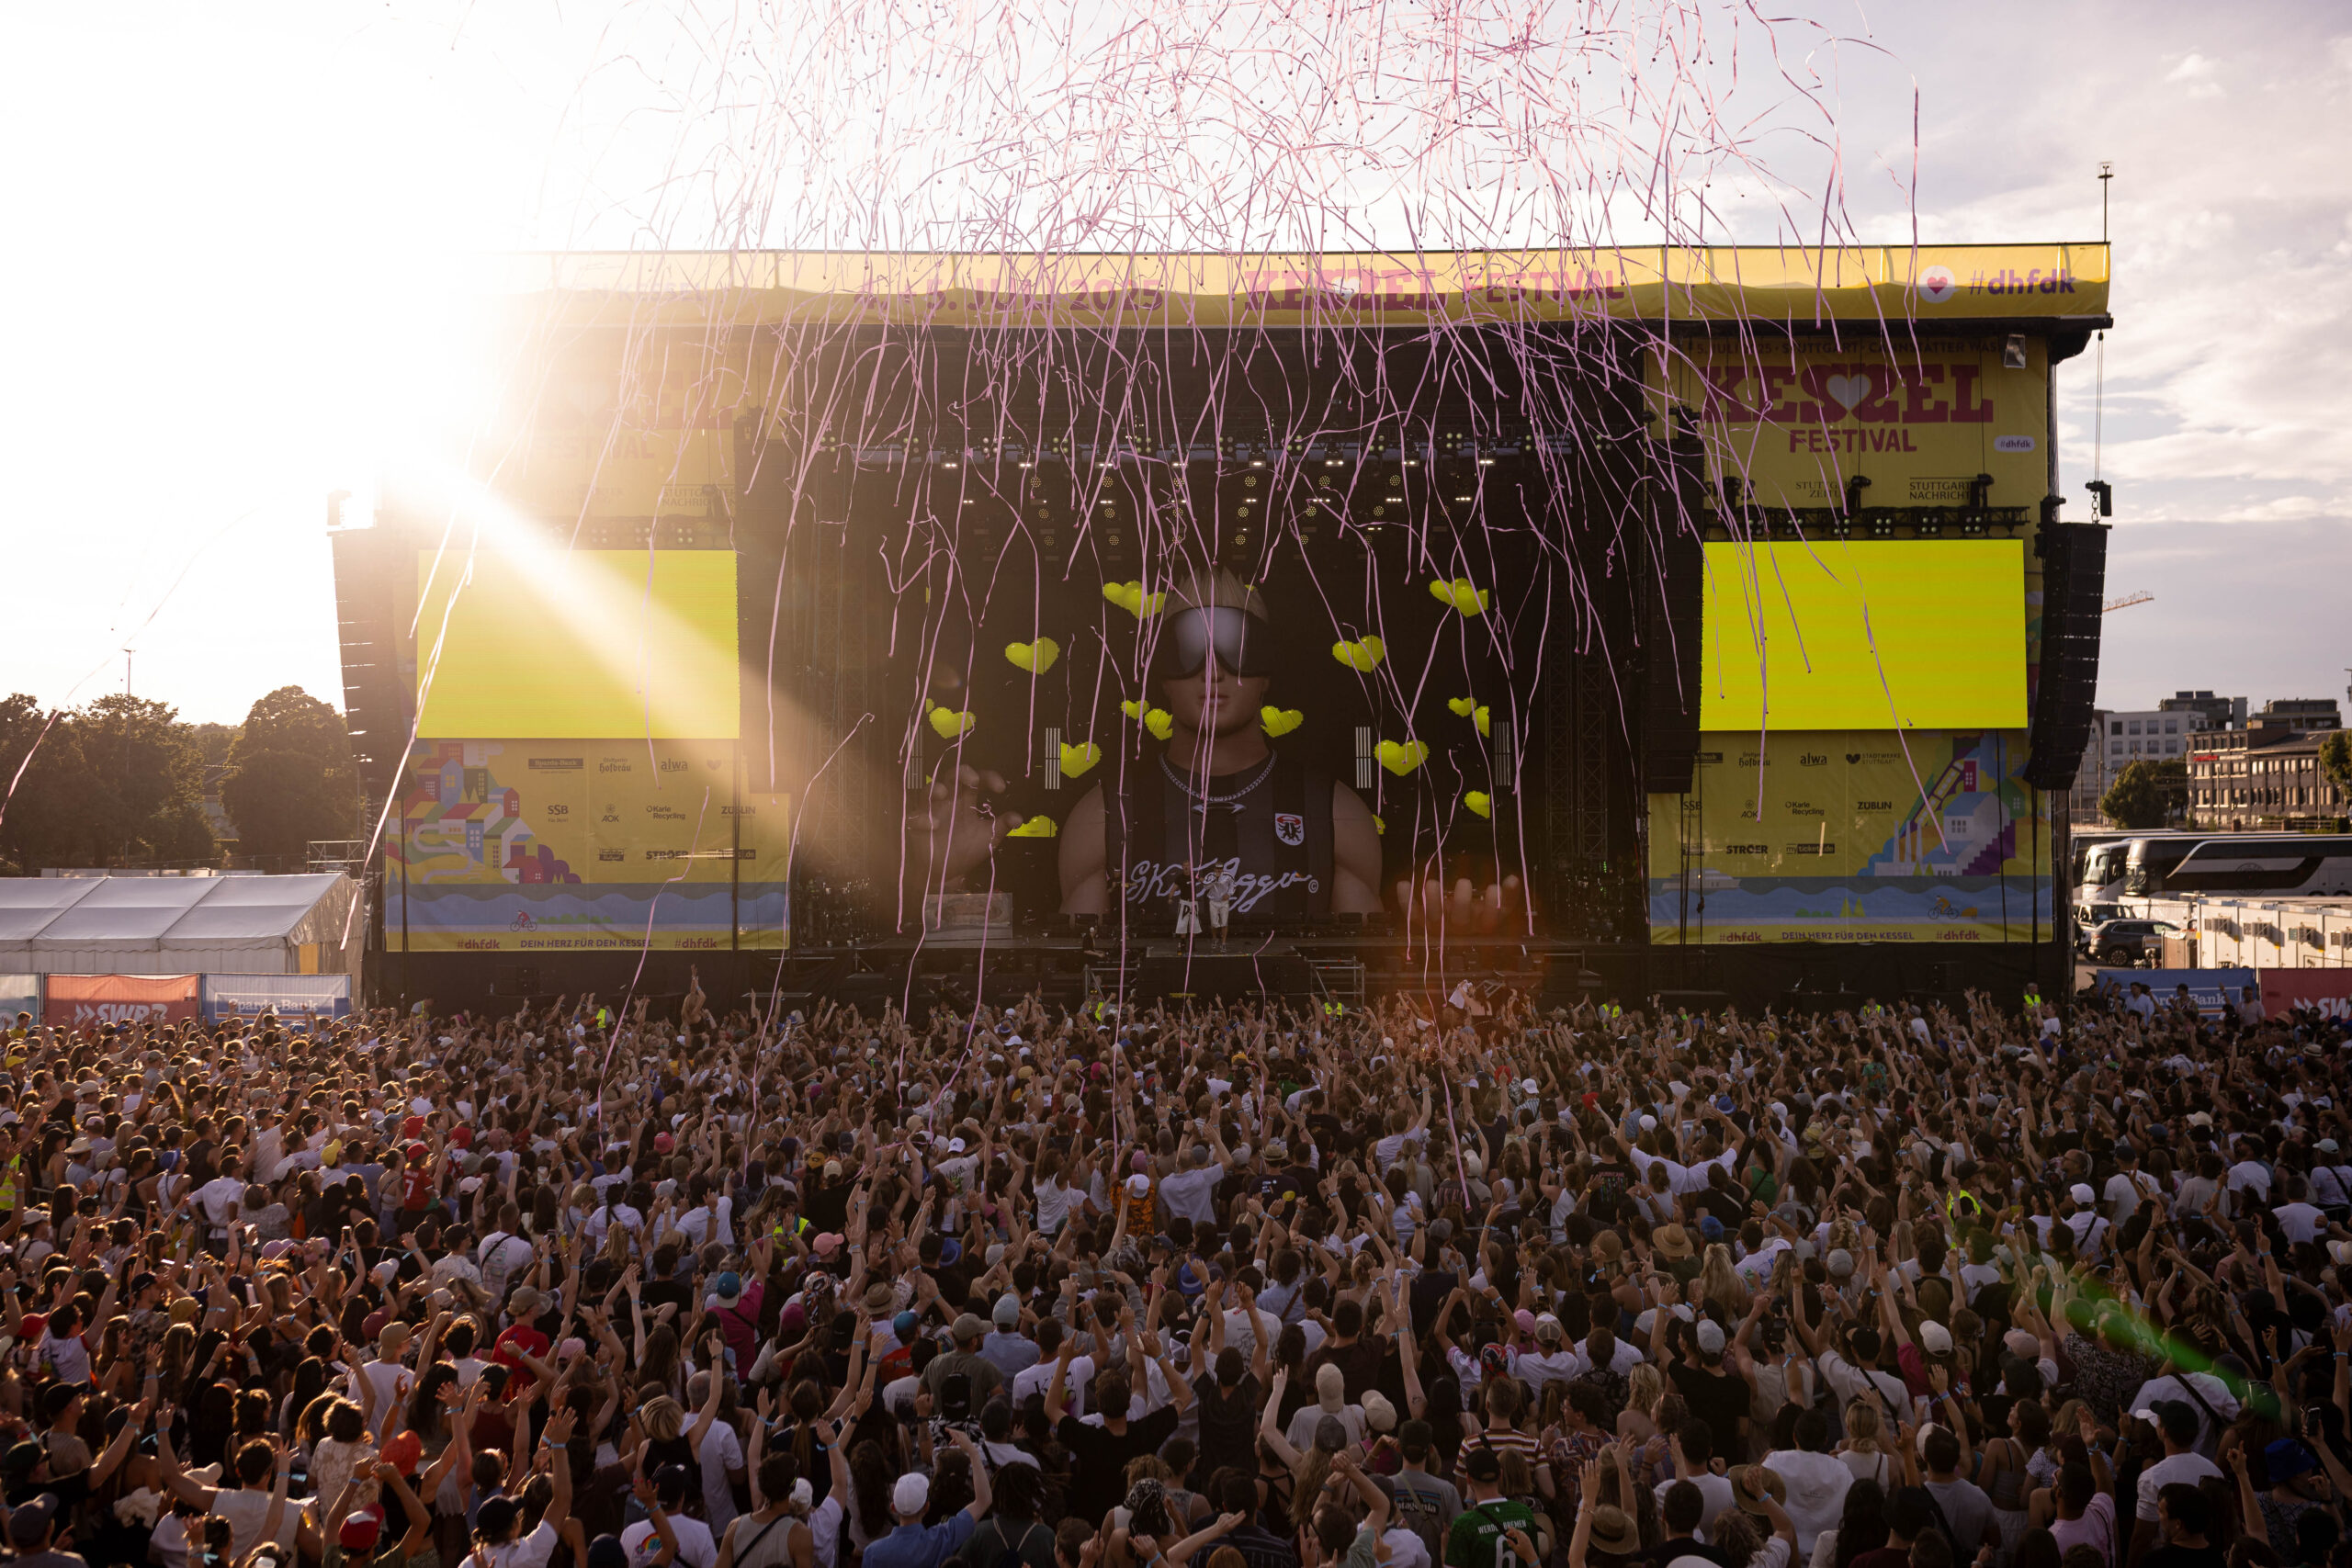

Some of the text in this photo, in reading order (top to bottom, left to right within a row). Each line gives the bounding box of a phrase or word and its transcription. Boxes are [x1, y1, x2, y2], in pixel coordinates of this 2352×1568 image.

[1464, 270, 1625, 304] FESTIVAL
[1969, 268, 2076, 297] #dhfdk
[1069, 278, 1164, 311] 2025
[1789, 428, 1918, 454] FESTIVAL
[1801, 752, 1827, 764] alwa
[661, 759, 688, 770] alwa
[548, 805, 569, 816] SSB
[1719, 931, 1762, 942] #dhfdk
[1782, 931, 1915, 941] DEIN HERZ FÜR DEN KESSEL
[1936, 930, 1981, 942] #dhfdk
[457, 939, 501, 950] #dhfdk
[520, 938, 653, 948] DEIN HERZ FÜR DEN KESSEL
[674, 938, 718, 949] #dhfdk
[404, 1179, 415, 1201] 7
